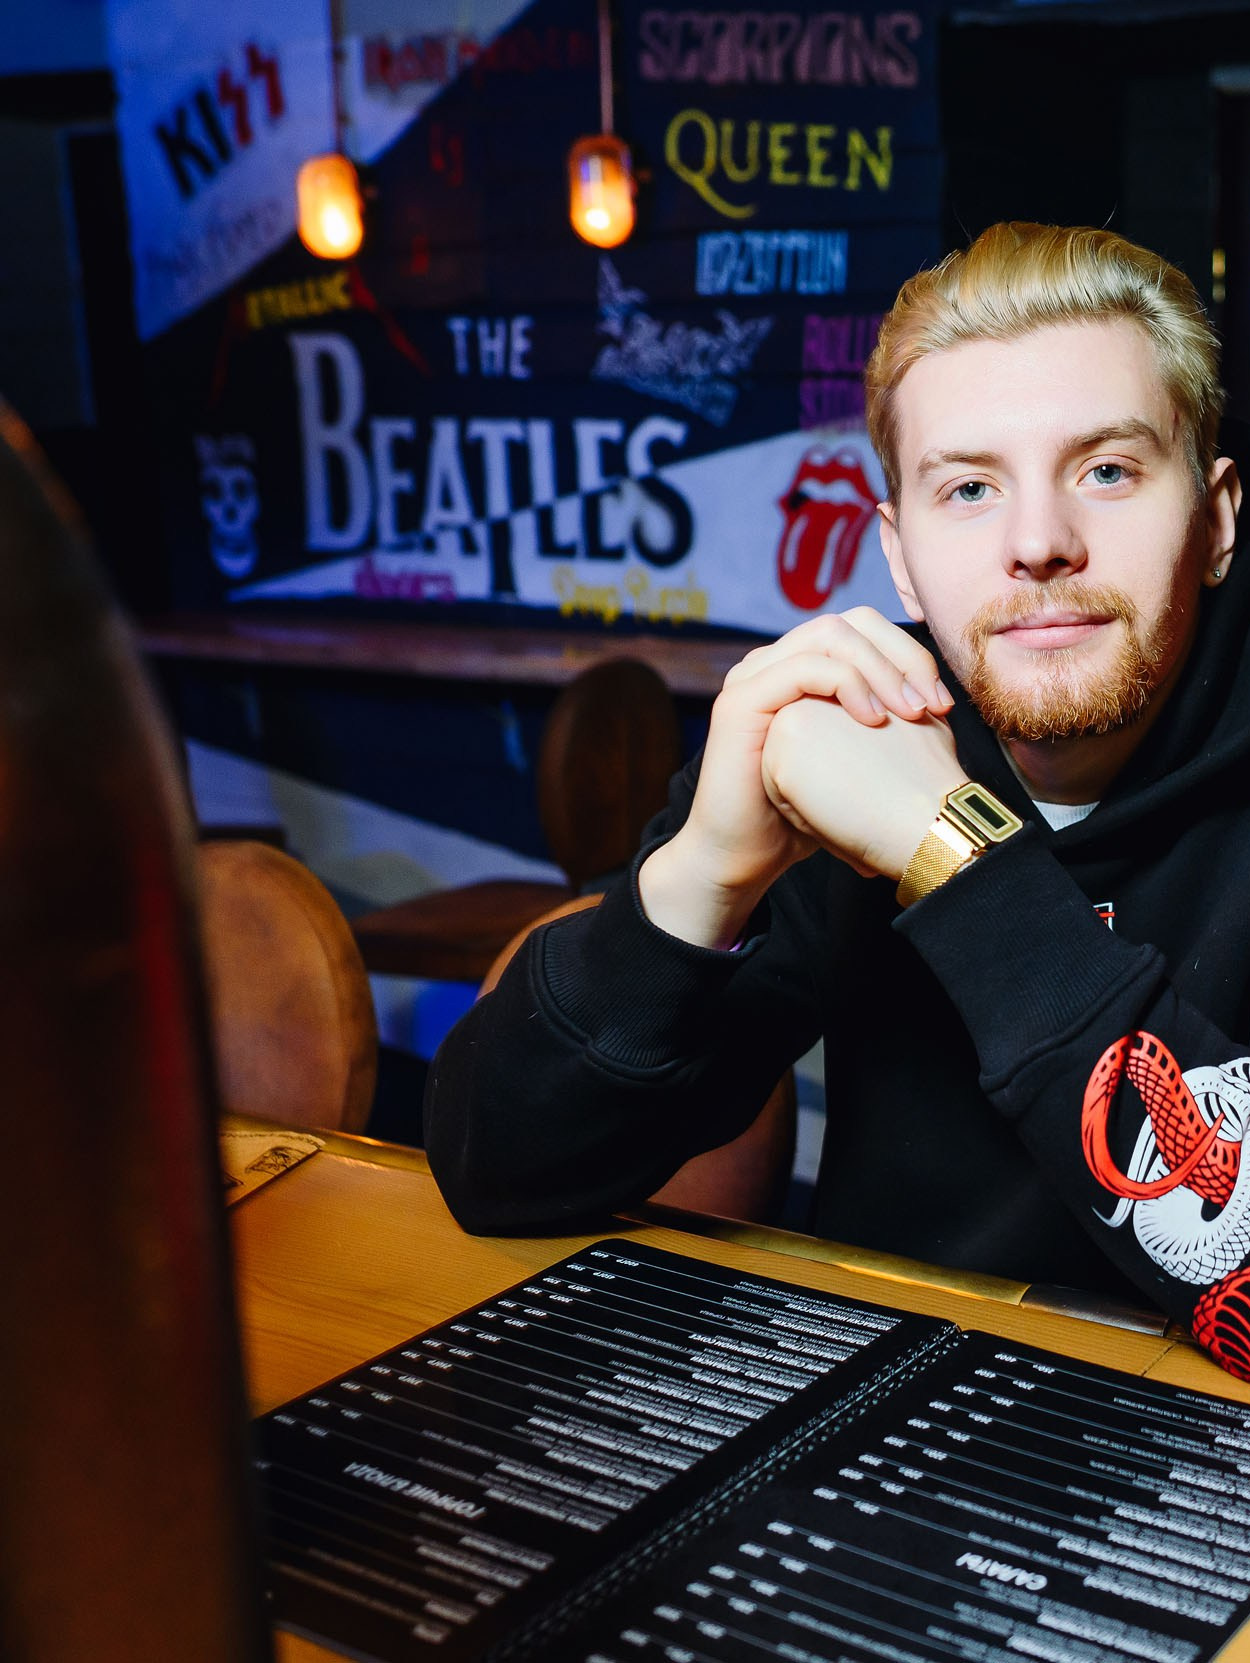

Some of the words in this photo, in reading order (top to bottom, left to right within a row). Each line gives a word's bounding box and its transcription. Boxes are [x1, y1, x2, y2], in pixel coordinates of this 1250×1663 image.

[639, 10, 924, 89] SCORPIONS
[154, 39, 283, 199] KISS
[664, 107, 895, 219] QUEEN
[446, 316, 534, 380] THE
[802, 310, 882, 370] ROLLI
[286, 329, 693, 598] BEATLES
[769, 1319, 827, 1336] МЮНХЕНСКИЕ
[785, 1303, 850, 1321] НЮРНБЕРГСКИЕ
[846, 1317, 891, 1331] КОЛБАСКИ
[777, 1341, 805, 1351] ГРИЛЬ
[801, 1347, 848, 1361] КОЛБАСКИ
[824, 1332, 870, 1346] КОЛБАСКИ
[344, 1462, 411, 1491] БЛЮДА
[403, 1484, 485, 1518] ГОРЯЧИЕ
[956, 1552, 1047, 1590] САЛАТЫ
